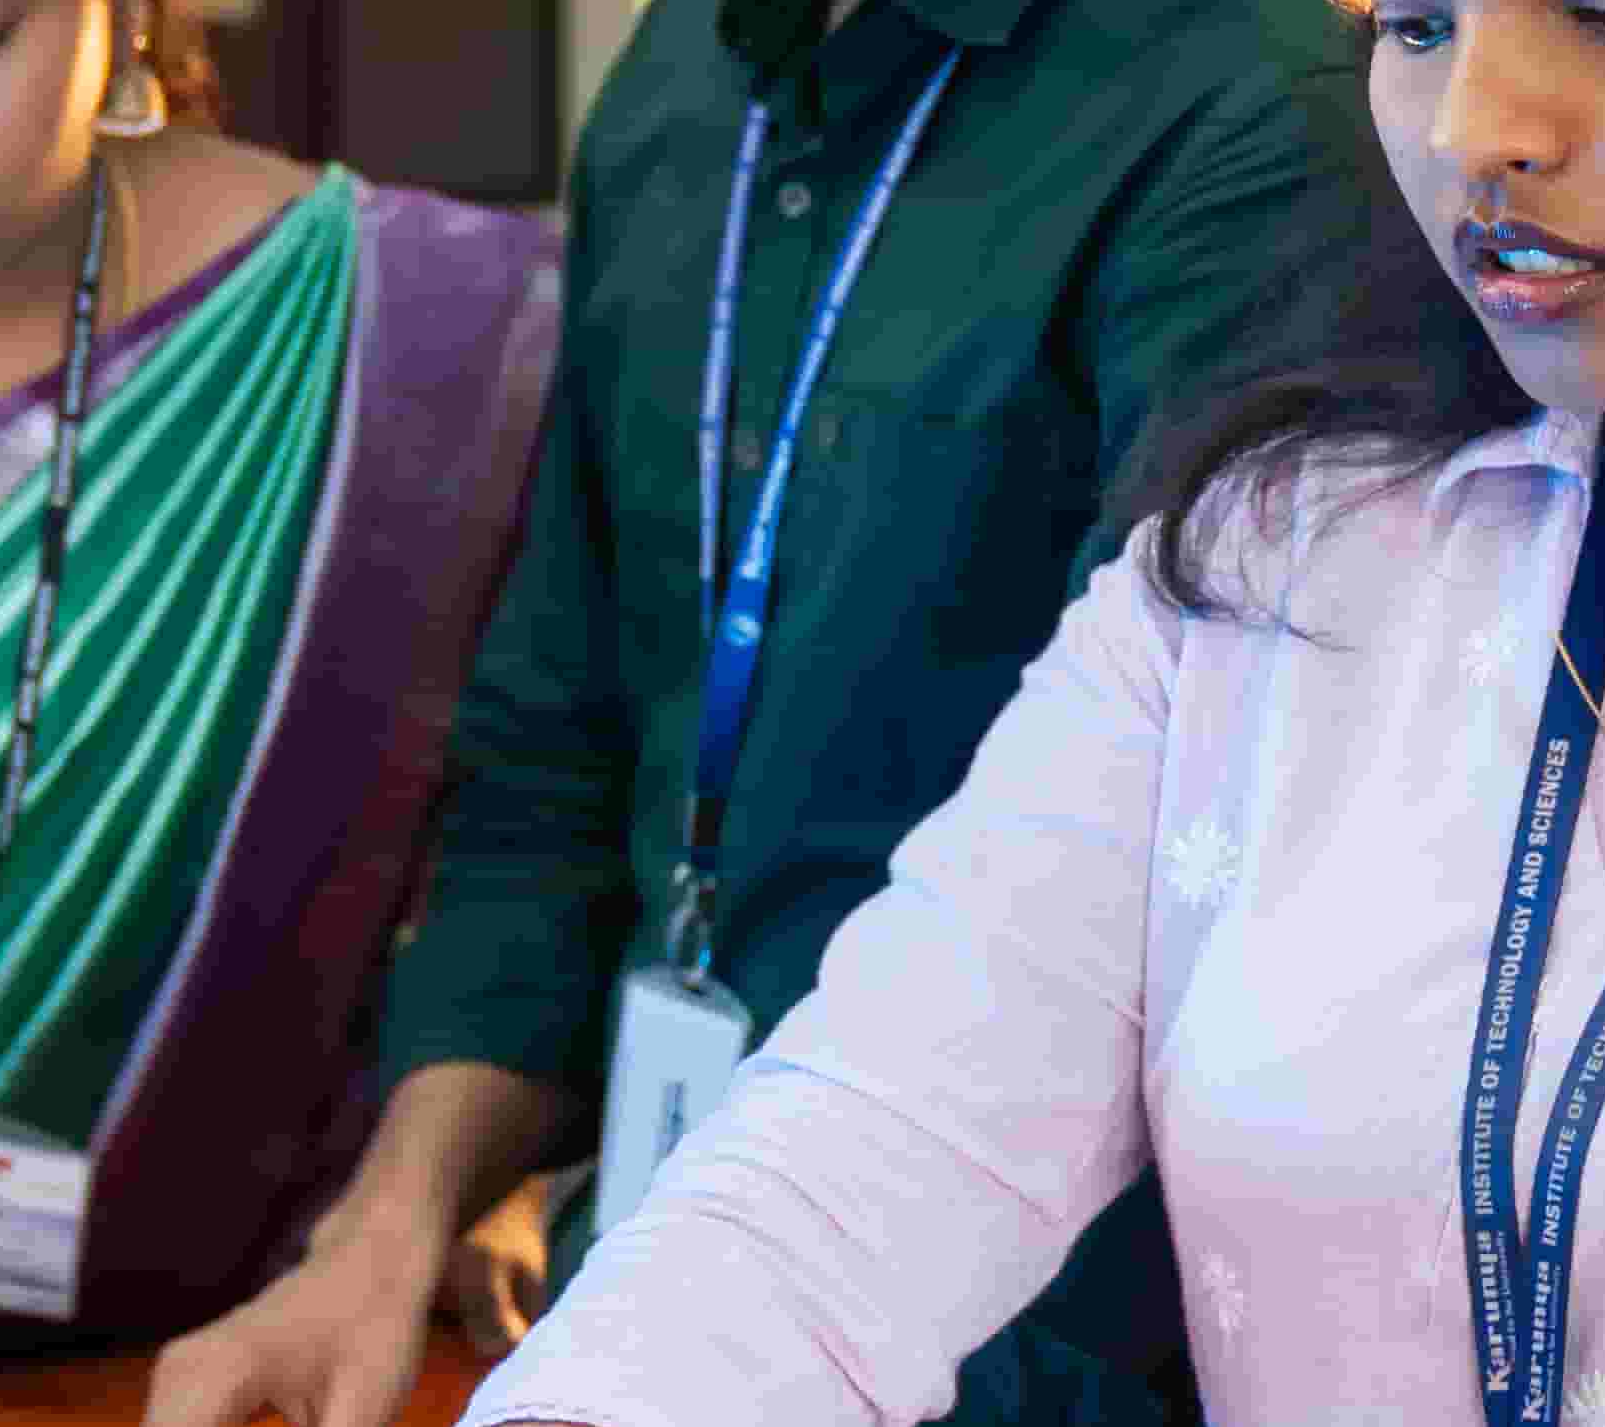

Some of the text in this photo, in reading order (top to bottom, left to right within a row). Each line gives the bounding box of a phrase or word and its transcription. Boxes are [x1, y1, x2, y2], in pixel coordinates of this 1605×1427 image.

[1473, 737, 1570, 1392] Karunya INSTITUTE OF TECHNOLOGY AND SCIENCES
[1522, 1260, 1550, 1422] Karunya
[1540, 1125, 1577, 1247] INSTITUTE
[1567, 1086, 1588, 1119] OF
